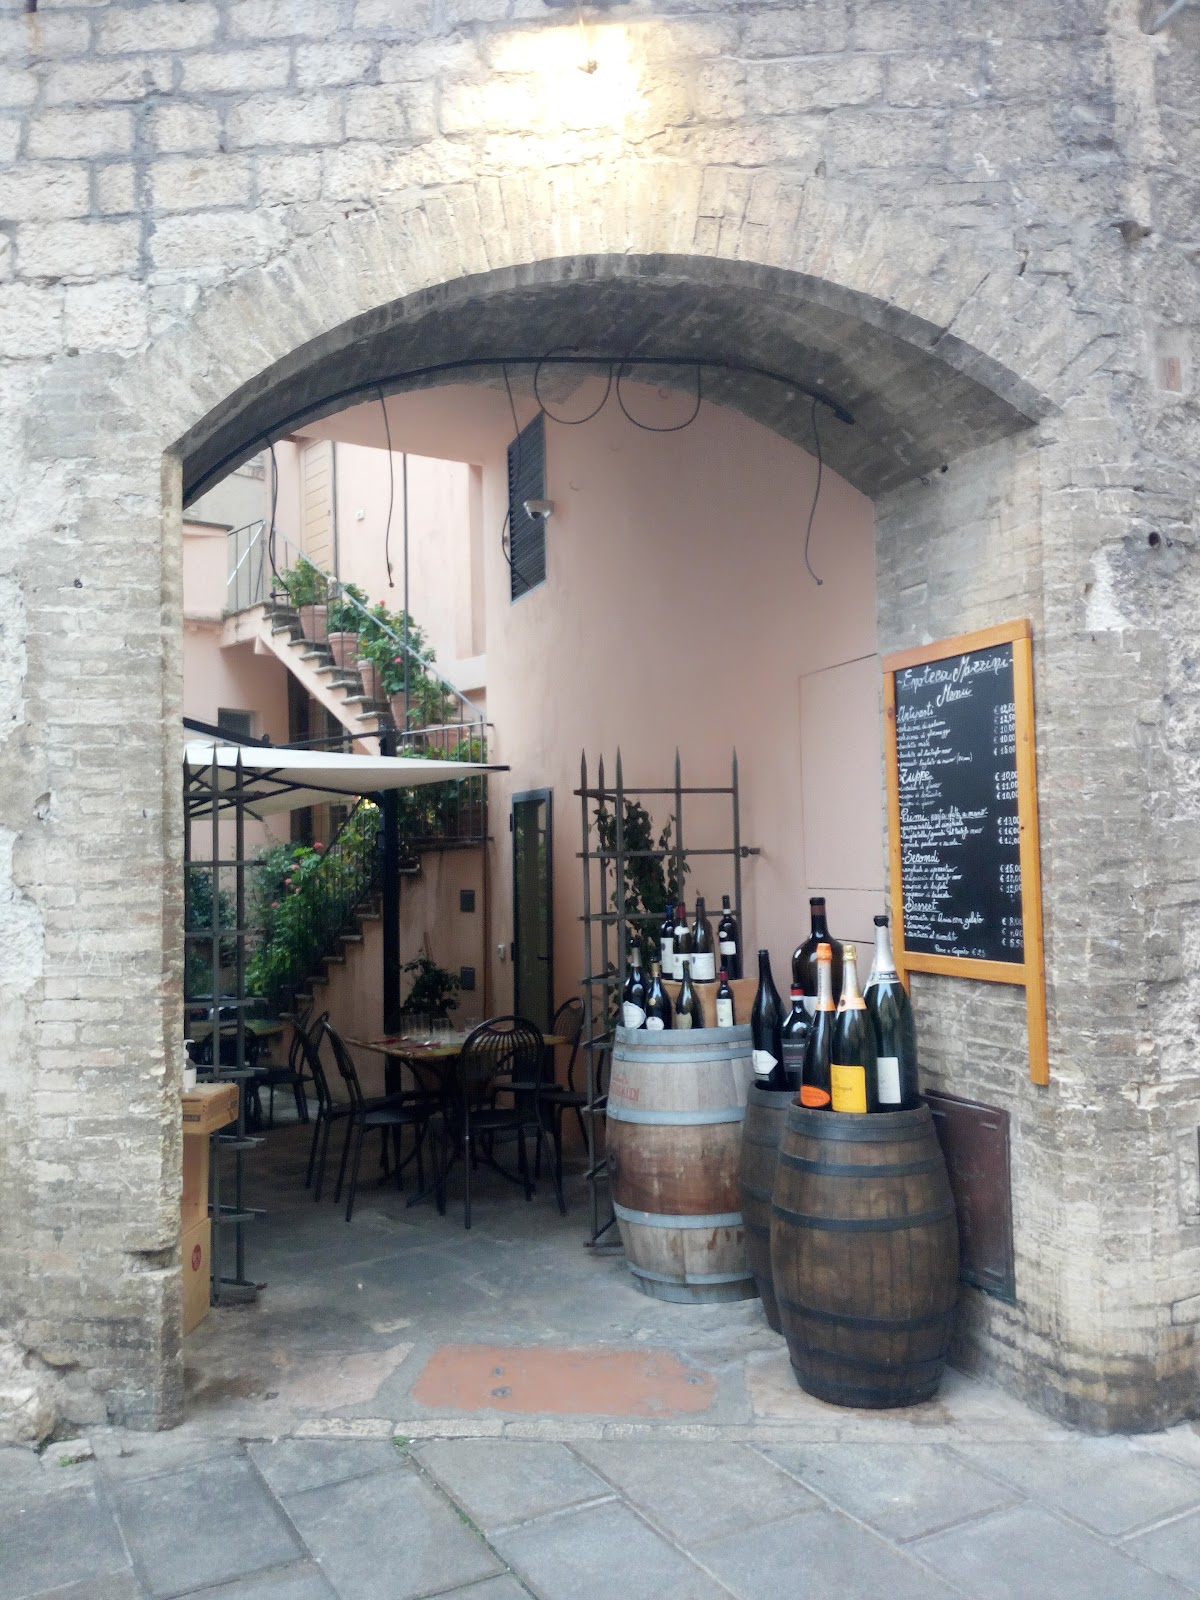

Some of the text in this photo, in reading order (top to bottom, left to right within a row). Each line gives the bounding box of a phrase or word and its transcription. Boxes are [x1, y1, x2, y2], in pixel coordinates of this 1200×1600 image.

[952, 652, 1009, 683] Mazzini
[899, 768, 933, 787] Zuppe
[901, 807, 929, 823] Primi
[904, 850, 940, 864] Secondi
[904, 895, 939, 913] Dessert
